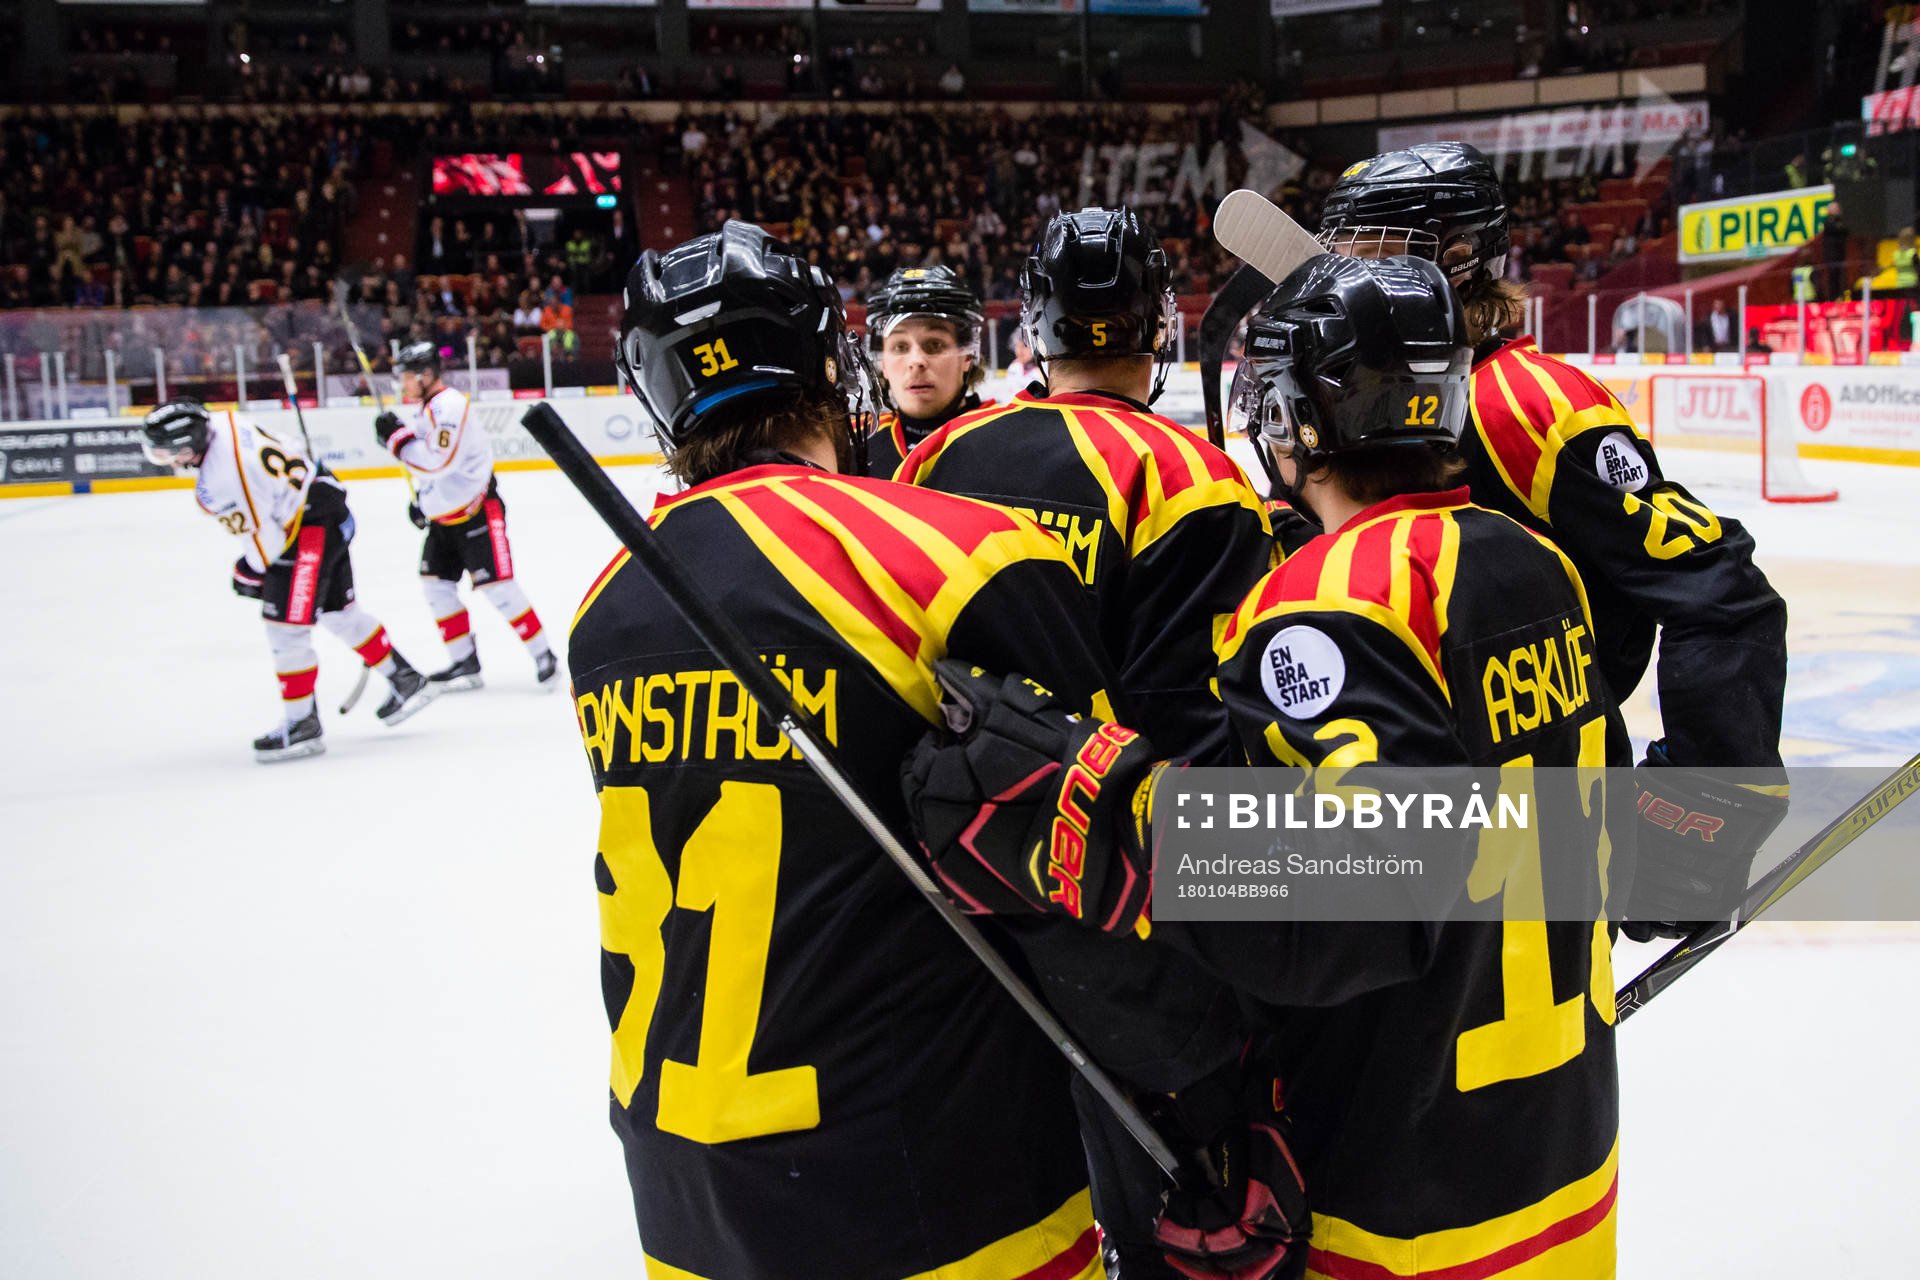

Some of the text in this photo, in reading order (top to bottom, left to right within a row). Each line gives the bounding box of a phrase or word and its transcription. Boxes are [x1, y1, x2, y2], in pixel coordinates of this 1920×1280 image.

[1078, 140, 1229, 207] ITEM
[1450, 256, 1479, 275] BAUER
[1092, 323, 1106, 347] 5
[693, 338, 739, 377] 31
[1404, 395, 1439, 426] 12
[438, 429, 450, 449] 6
[1602, 443, 1618, 459] EN
[1605, 456, 1630, 473] BRA
[1609, 466, 1644, 486] START
[218, 511, 249, 535] 32
[1622, 487, 1722, 560] 20
[1269, 646, 1292, 669] EN
[1274, 662, 1309, 689] BRA
[1482, 618, 1592, 744] ASKLÖF
[1280, 677, 1331, 708] START
[1048, 722, 1140, 919] BAUER
